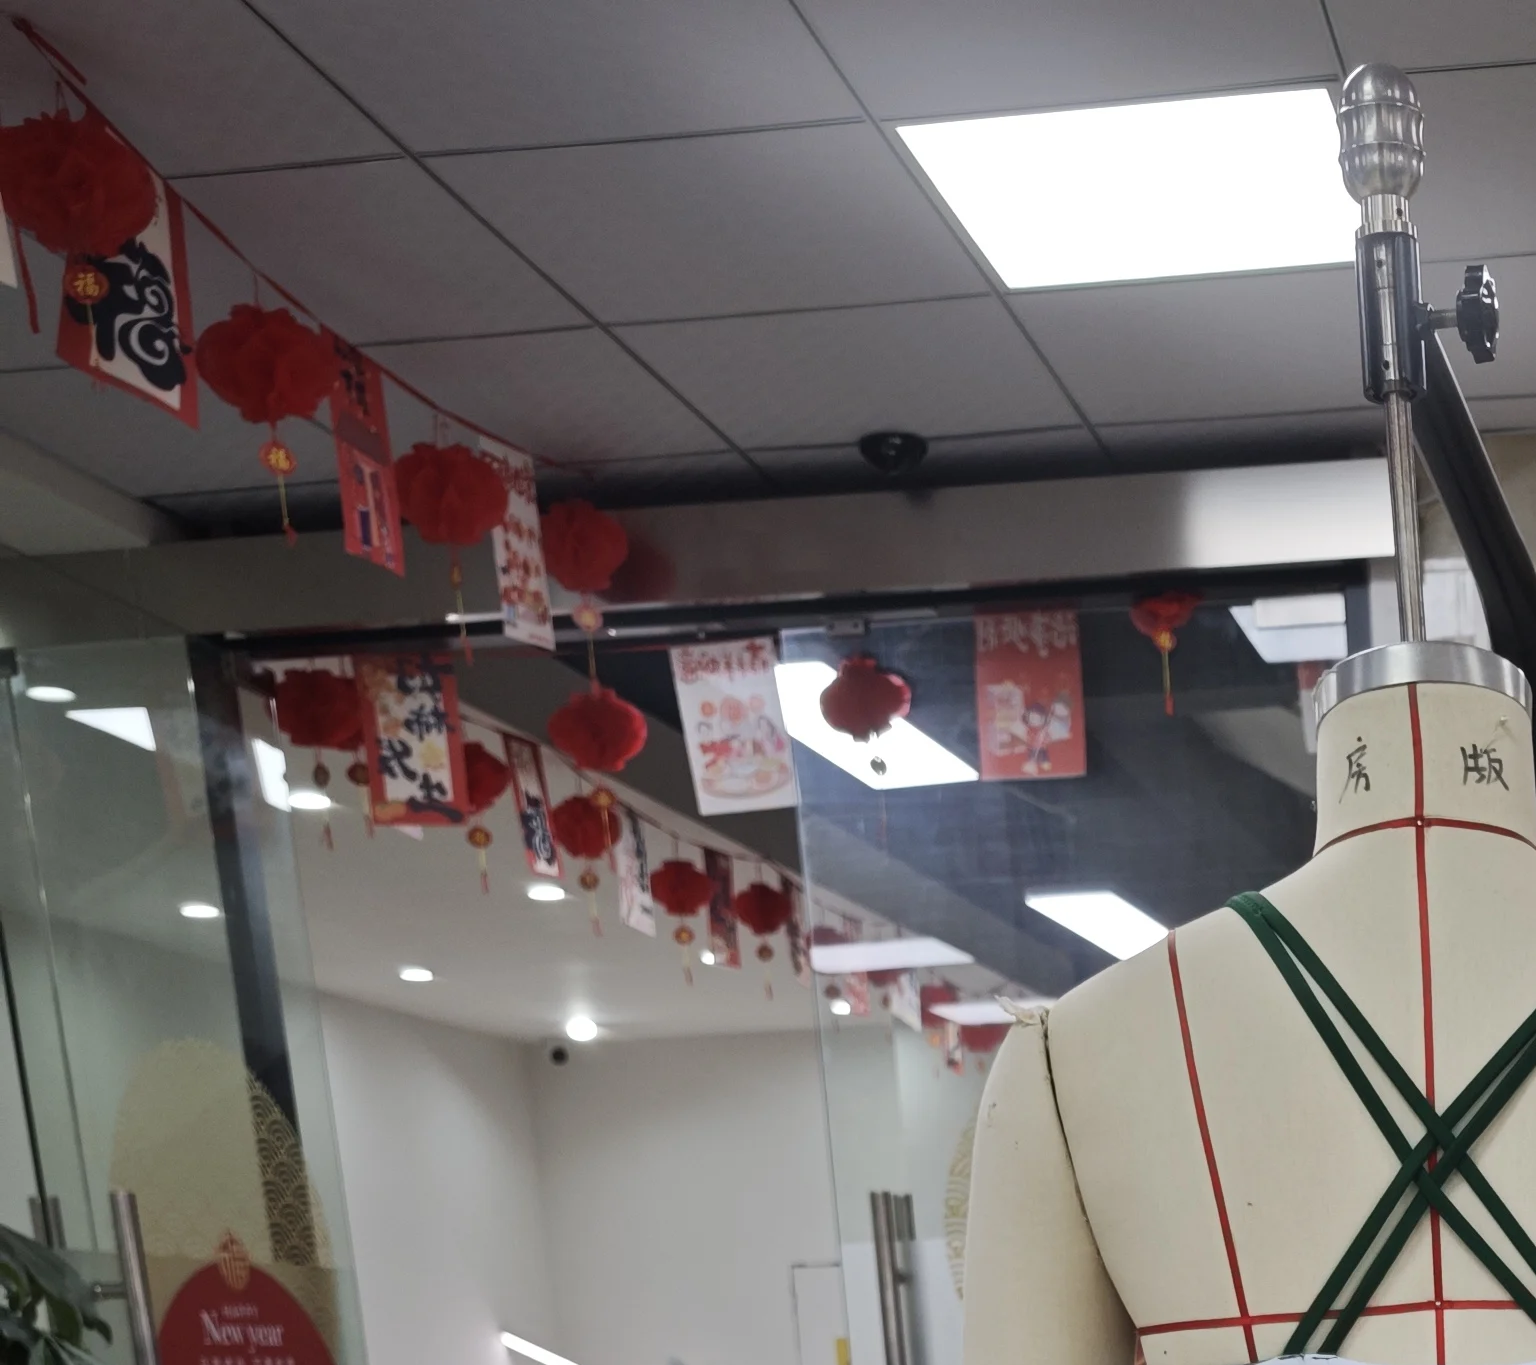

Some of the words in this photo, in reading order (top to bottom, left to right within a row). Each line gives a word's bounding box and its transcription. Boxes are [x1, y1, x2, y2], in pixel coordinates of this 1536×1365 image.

[74, 272, 99, 297] 福
[1460, 743, 1510, 791] 版
[199, 1308, 245, 1346] New
[246, 1324, 285, 1354] year
